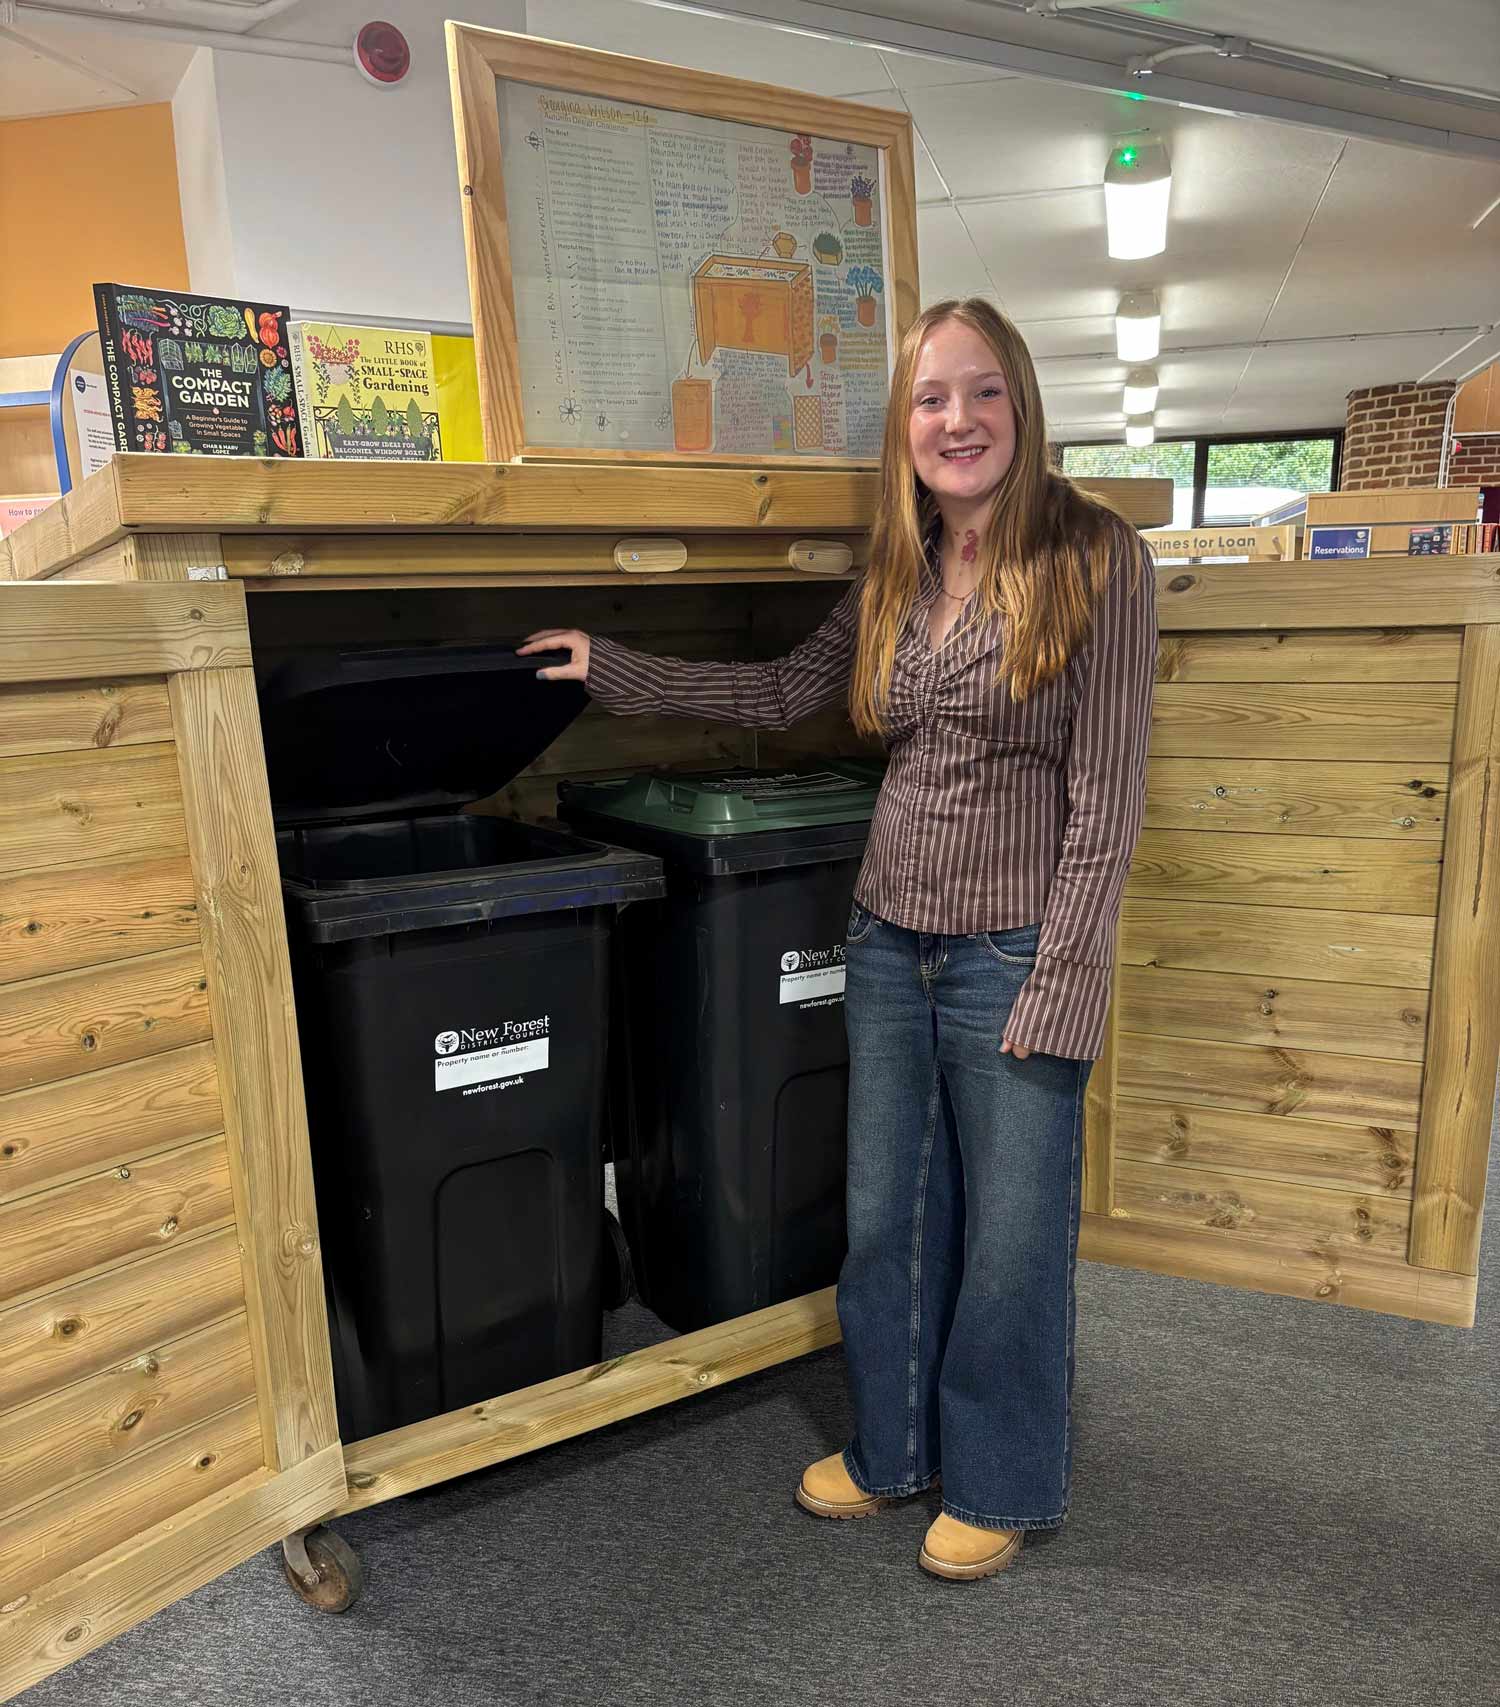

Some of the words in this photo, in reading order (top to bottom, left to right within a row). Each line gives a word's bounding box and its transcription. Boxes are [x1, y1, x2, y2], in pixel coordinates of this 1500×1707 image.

[546, 291, 556, 311] BIN
[549, 319, 559, 341] THE
[105, 339, 116, 362] THE
[293, 344, 301, 362] RHS
[384, 340, 414, 355] RHS
[360, 356, 372, 364] The
[373, 357, 398, 365] LITTLE
[400, 359, 417, 367] BOOK
[554, 350, 564, 385] CHECK
[200, 367, 223, 378] THE
[361, 366, 428, 379] SMALL-SPACE
[109, 364, 124, 420] COMPACT
[172, 376, 252, 394] COMPACT
[363, 377, 430, 396] Gardening
[179, 390, 250, 408] GARDEN
[294, 366, 309, 424] SMALL-SPACE
[188, 421, 214, 430] Growing
[214, 423, 247, 431] Vegetables
[192, 414, 222, 423] Beginner's
[223, 416, 240, 424] Guide
[8, 508, 24, 516] How
[24, 508, 33, 516] to
[1193, 536, 1213, 549] for
[1218, 535, 1256, 548] Loan
[1314, 545, 1364, 555] Reservations
[800, 949, 830, 963] New
[800, 958, 833, 969] DISTRICT
[781, 975, 805, 983] Property
[460, 1027, 499, 1043] New
[503, 1015, 550, 1036] Forest
[460, 1037, 505, 1050] DISTRICT
[509, 1028, 549, 1041] COUNCIL
[437, 1057, 468, 1068] Property
[470, 1053, 490, 1062] name
[462, 1076, 524, 1096] newforest.gov.uk
